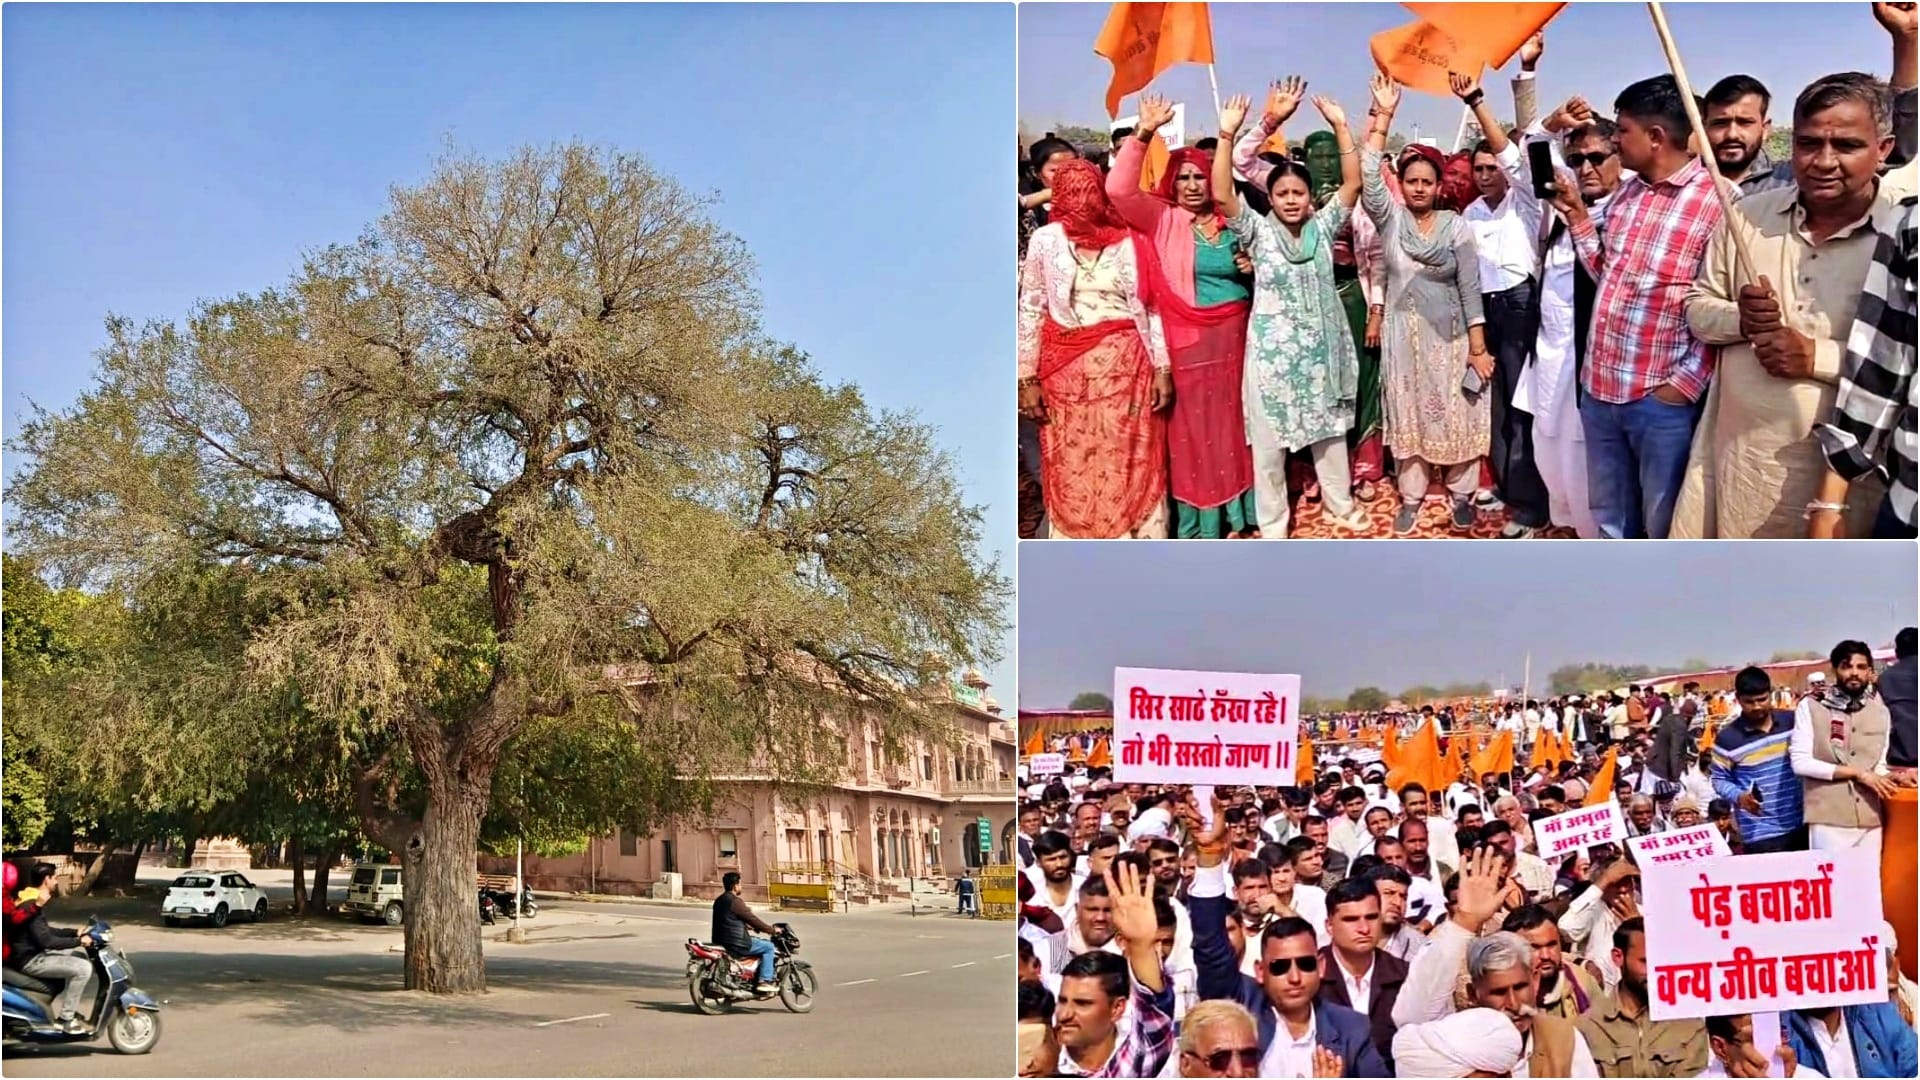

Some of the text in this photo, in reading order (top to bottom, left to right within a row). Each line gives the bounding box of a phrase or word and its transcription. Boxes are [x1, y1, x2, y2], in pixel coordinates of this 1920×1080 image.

[1129, 686, 1166, 720] सिर
[1122, 732, 1145, 766] तो
[1148, 734, 1172, 767] भी
[1175, 734, 1223, 768] सस्तो
[1225, 743, 1271, 769] जाण
[1566, 808, 1611, 829] अमृता
[1552, 836, 1589, 852] अमर
[1663, 829, 1710, 847] अमृता
[1690, 863, 1834, 939] पेड़ बचाओं
[1655, 936, 1879, 1005] वन्य जीव बचाओं
